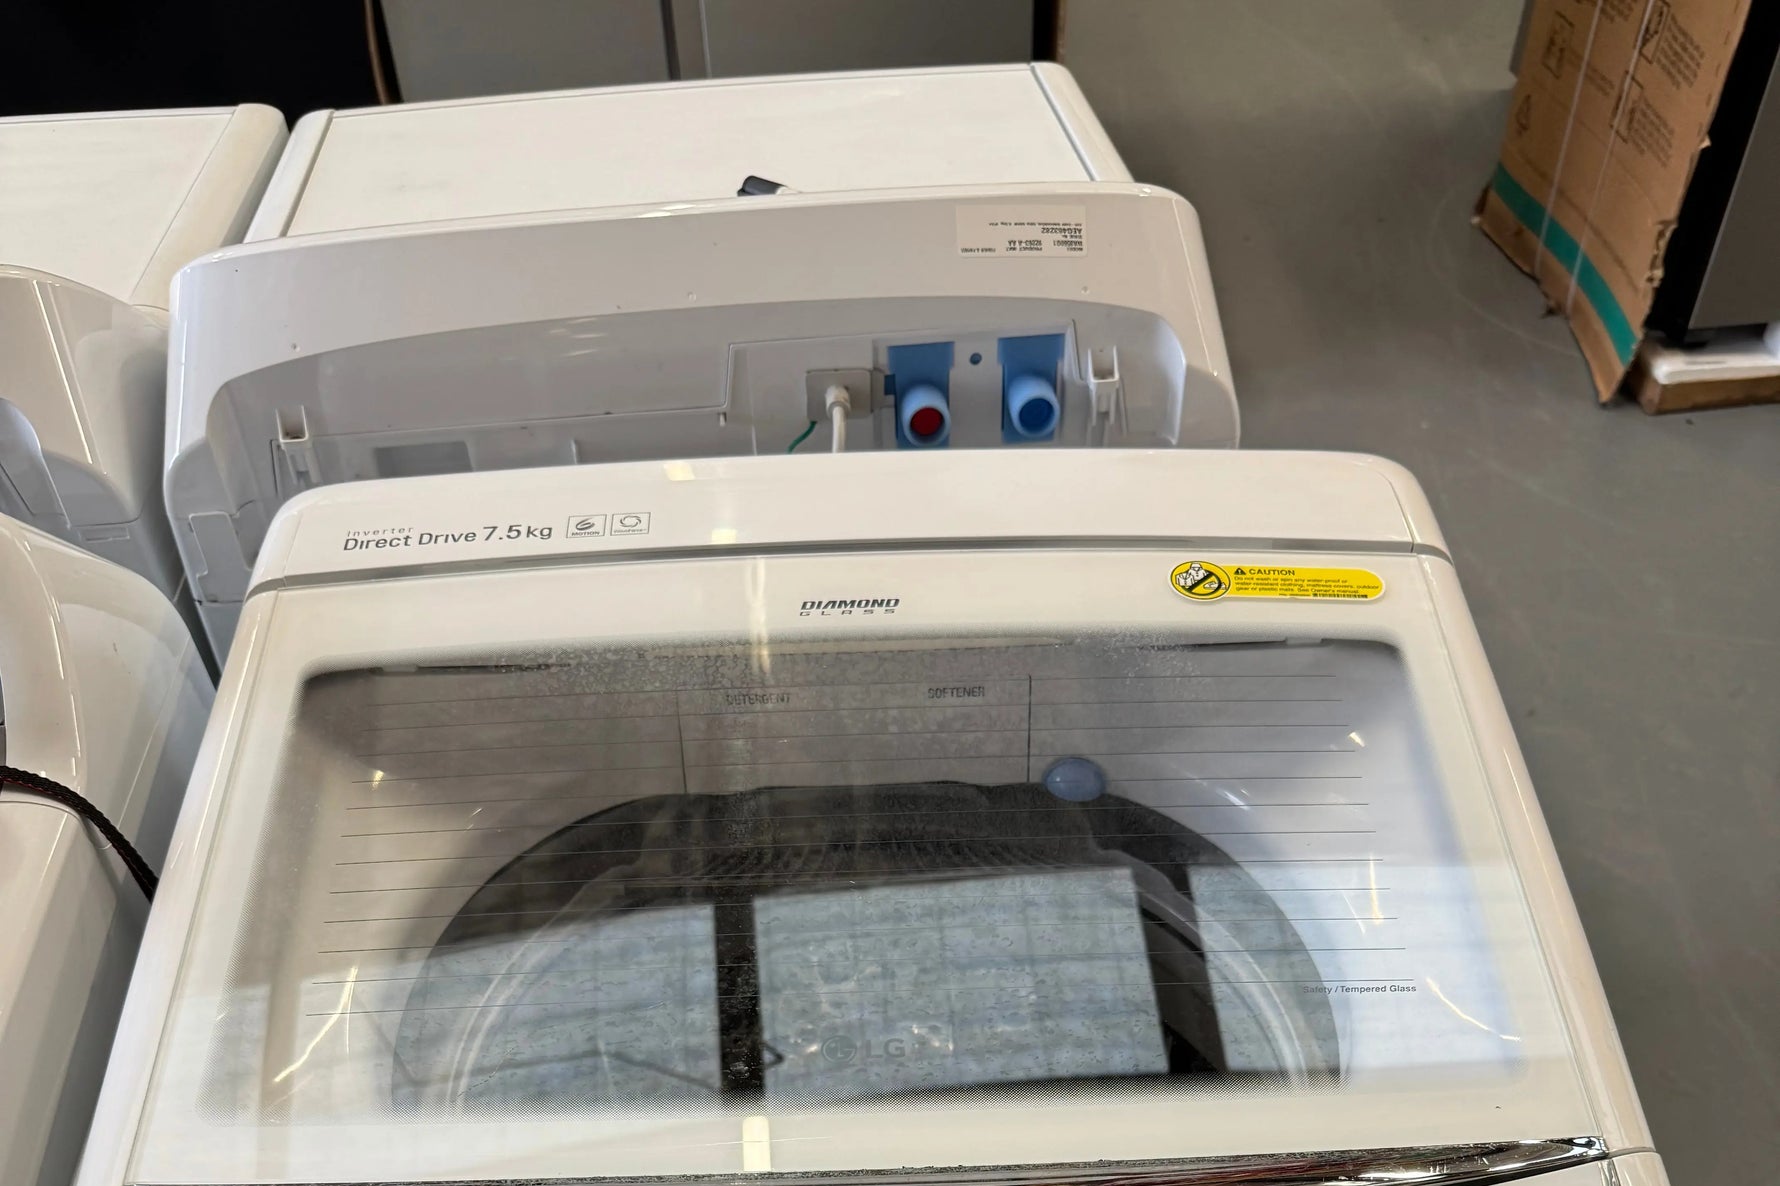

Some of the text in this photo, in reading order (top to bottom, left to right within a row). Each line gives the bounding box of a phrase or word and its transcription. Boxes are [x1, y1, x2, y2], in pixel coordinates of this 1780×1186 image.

[344, 534, 412, 551] Direct
[418, 530, 477, 546] Drive
[1248, 568, 1296, 576] CAUTION
[800, 598, 900, 611] DIAMOND
[800, 608, 896, 616] GLASS
[928, 686, 985, 699] SOFTENER
[1304, 985, 1332, 994] Safety
[1340, 985, 1386, 994] Tempered
[1390, 984, 1416, 992] Glass
[865, 1038, 906, 1059] LG
